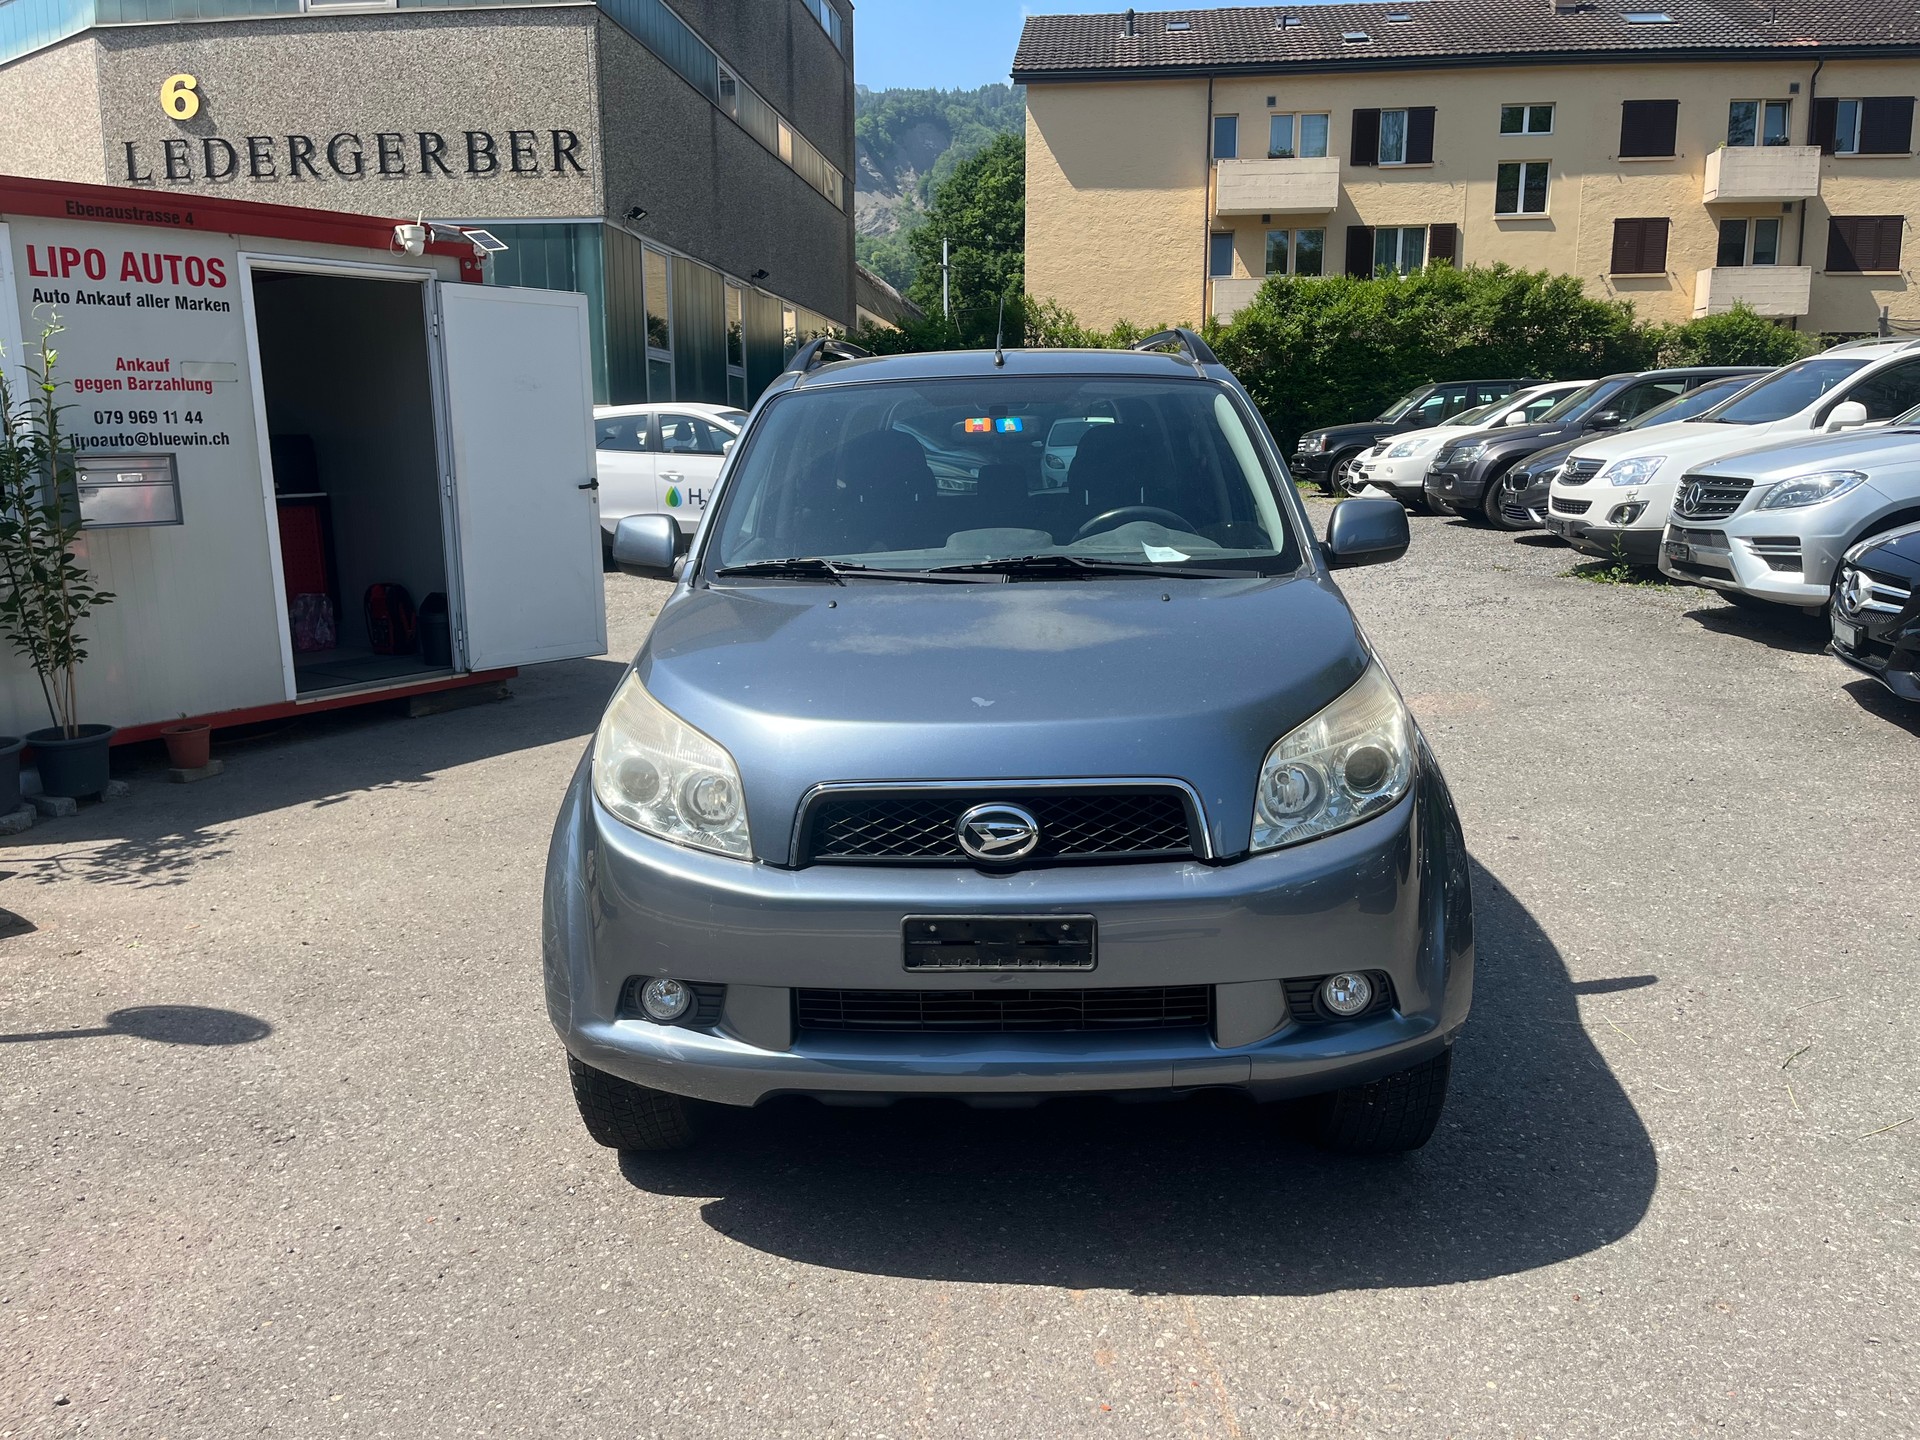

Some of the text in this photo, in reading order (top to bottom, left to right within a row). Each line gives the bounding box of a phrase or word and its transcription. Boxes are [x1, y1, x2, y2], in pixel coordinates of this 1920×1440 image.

[160, 73, 200, 121] 6
[124, 129, 587, 182] LEDERGERBER
[66, 200, 194, 226] Ebenaustrasse 4
[26, 244, 227, 288] LIPO AUTOS
[32, 288, 230, 312] Auto Ankauf aller Marken
[115, 357, 170, 373] Ankauf
[74, 376, 213, 394] gegen Barzahlung
[94, 411, 203, 425] 079 969 11 44
